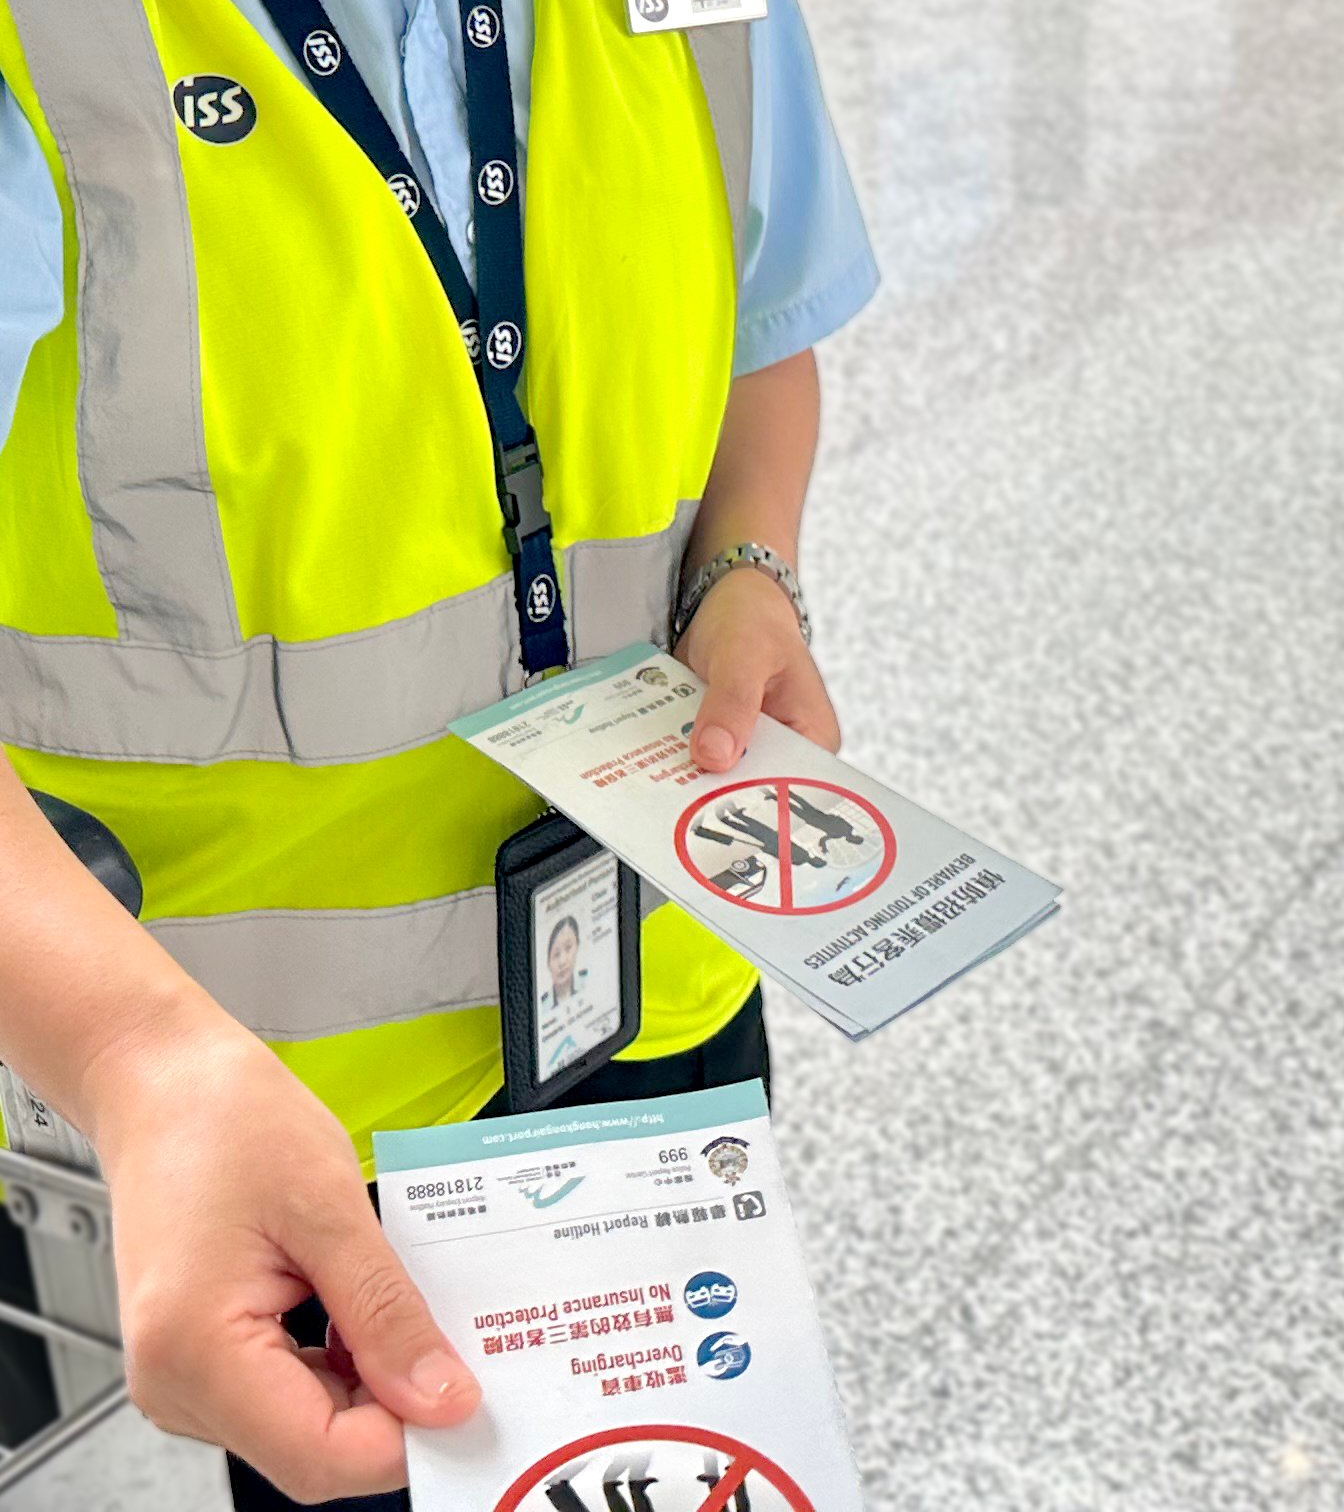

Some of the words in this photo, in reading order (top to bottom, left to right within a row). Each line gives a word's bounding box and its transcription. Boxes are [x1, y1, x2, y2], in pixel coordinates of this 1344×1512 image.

[931, 853, 977, 890] BEWARE
[910, 884, 931, 901] OF
[827, 868, 1006, 986] 慎防招攬乘客行為
[863, 895, 917, 931] TOUTING
[803, 924, 869, 969] ACTIVITIES
[481, 1112, 665, 1145] http://www.hongkongairport.com
[658, 1147, 688, 1164] 999
[407, 1175, 484, 1201] 21818888
[553, 1222, 602, 1240] Hotline
[604, 1213, 648, 1234] Report
[562, 1289, 645, 1314] Insurance
[649, 1283, 672, 1300] No
[474, 1305, 559, 1331] Protection
[482, 1304, 674, 1355] 無有效的第三者保險
[570, 1344, 683, 1376] Overcharging
[601, 1365, 688, 1397] 濫收車資
